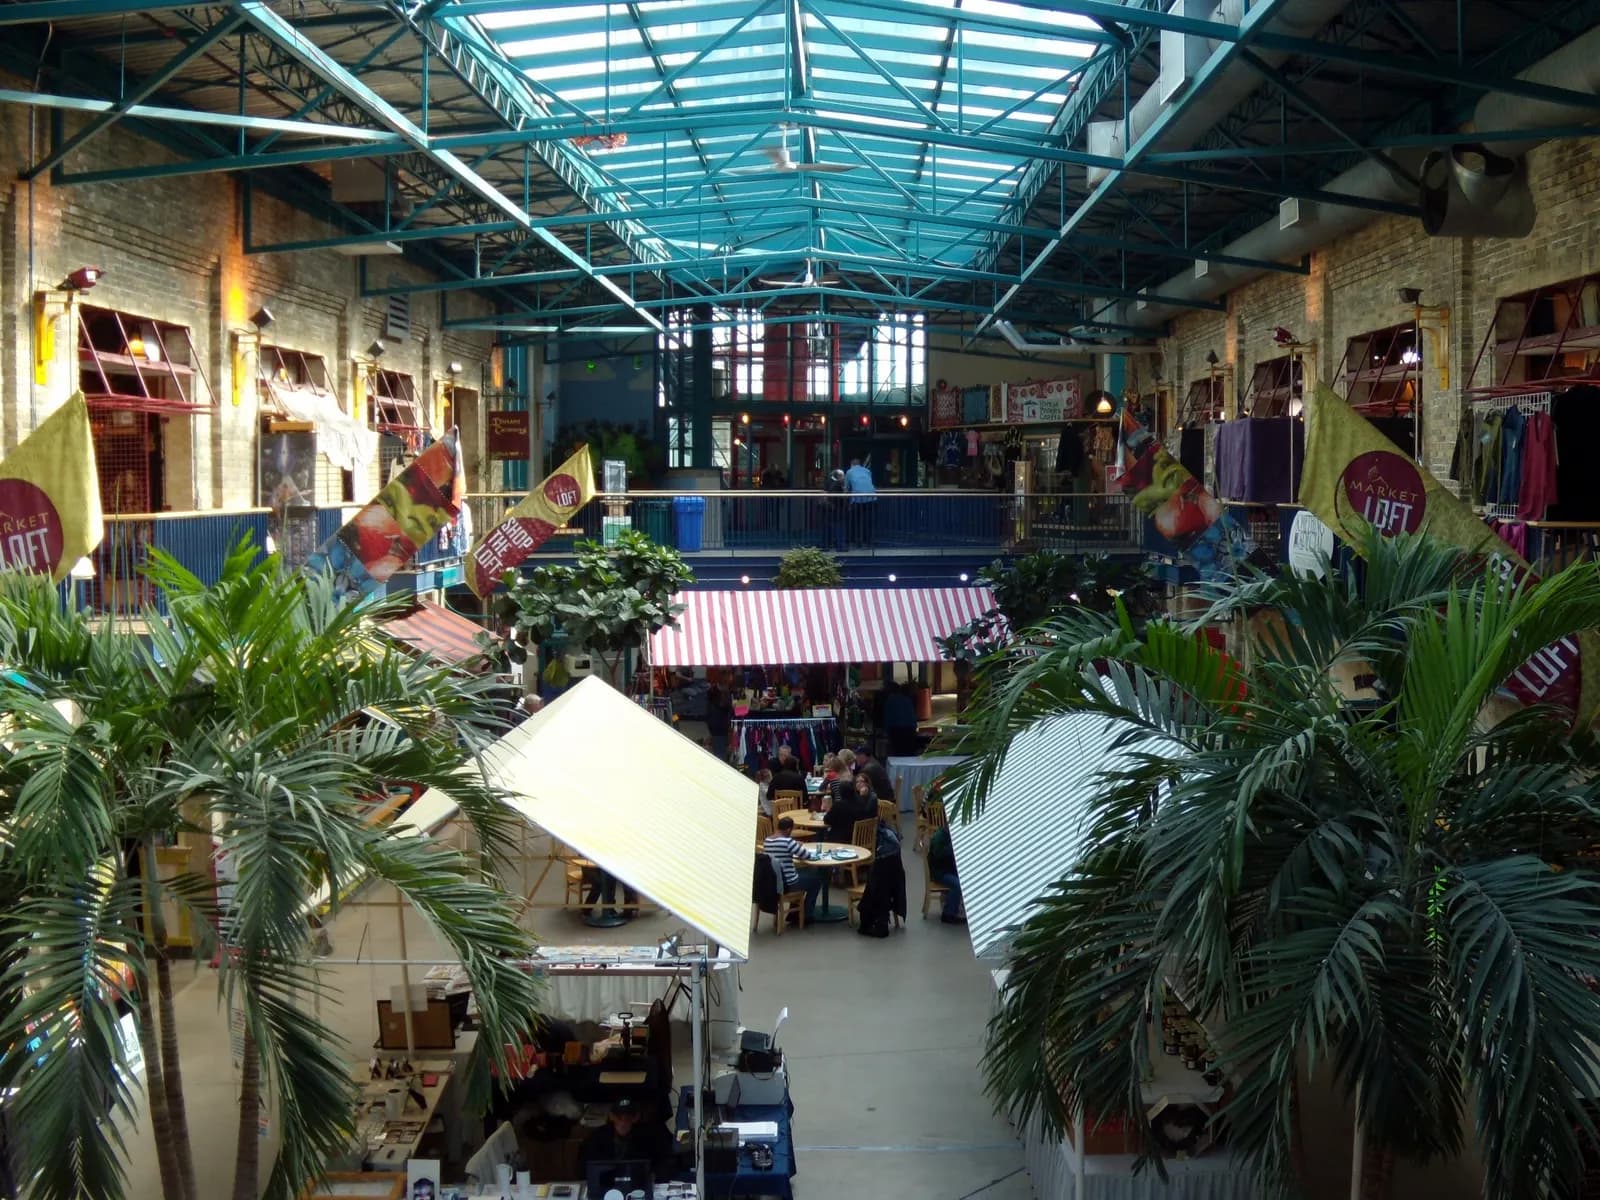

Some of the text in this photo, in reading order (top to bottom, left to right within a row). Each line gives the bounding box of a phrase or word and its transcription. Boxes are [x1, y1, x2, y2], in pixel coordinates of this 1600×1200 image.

[557, 491, 577, 507] LOFT
[1350, 480, 1419, 503] MARKET
[0, 512, 48, 534] RKET
[1363, 495, 1413, 531] LOFT
[488, 530, 512, 557] THE
[502, 517, 534, 549] SHOP
[474, 544, 504, 573] LOFT
